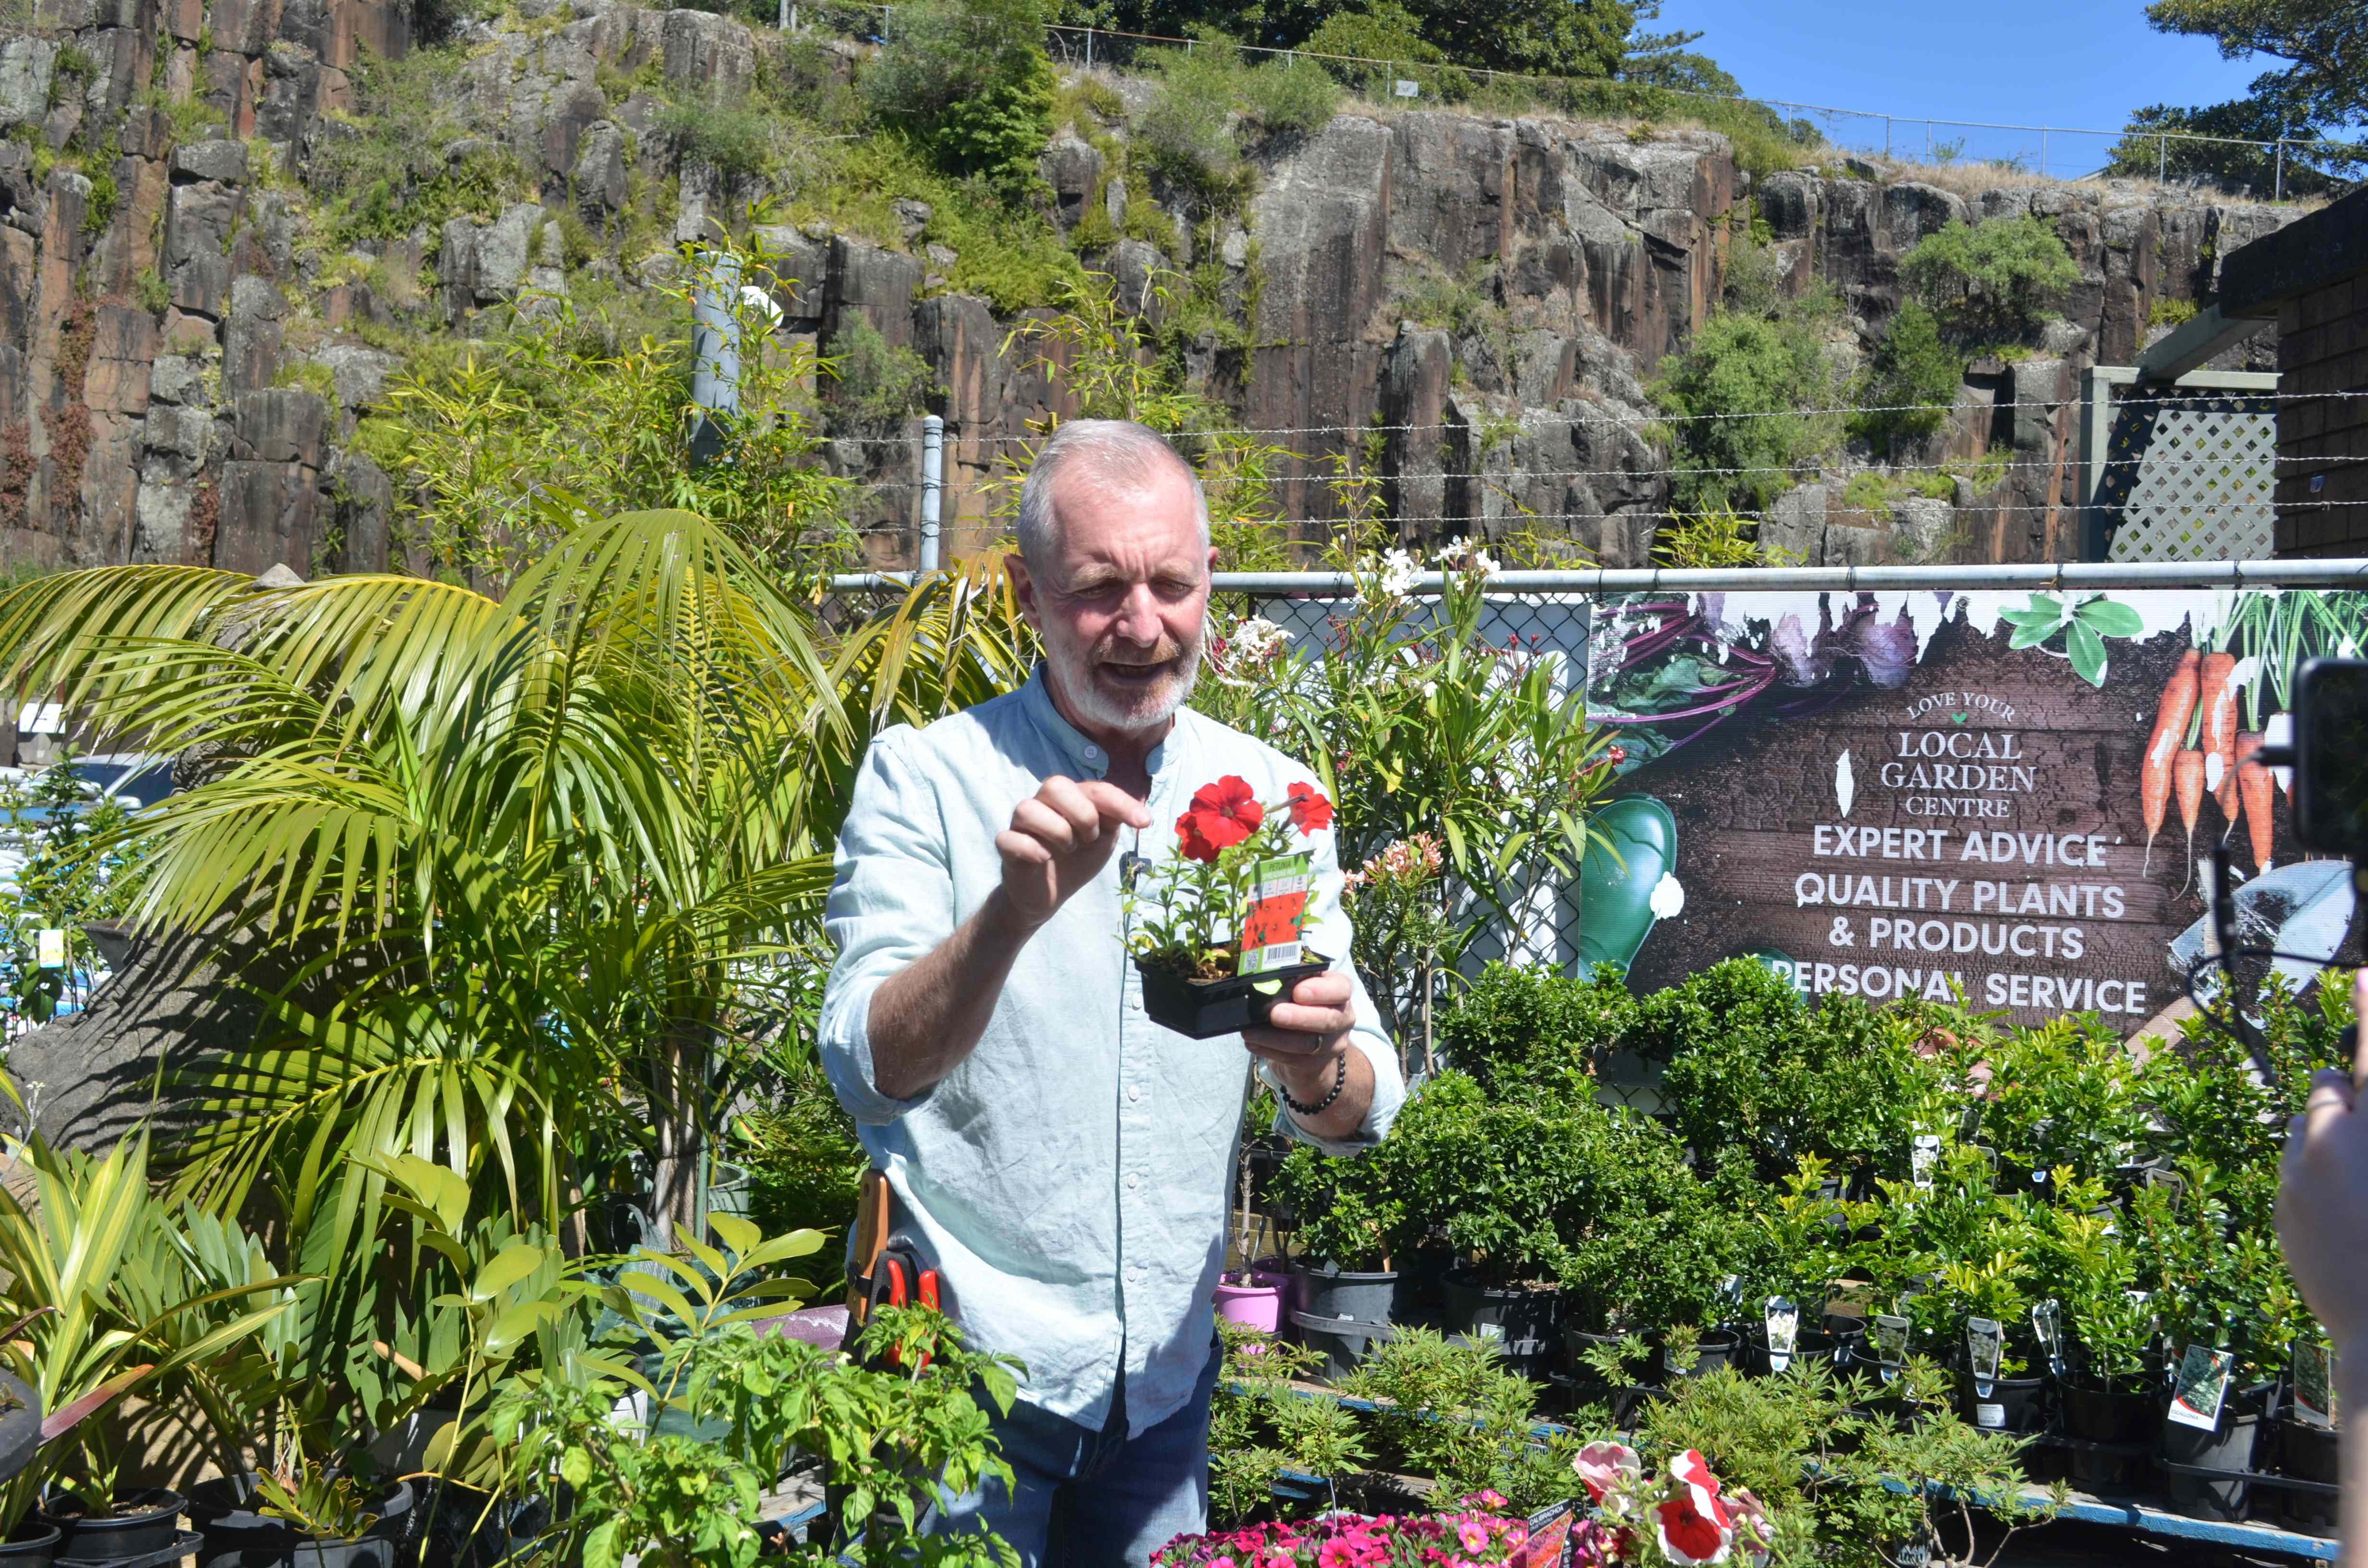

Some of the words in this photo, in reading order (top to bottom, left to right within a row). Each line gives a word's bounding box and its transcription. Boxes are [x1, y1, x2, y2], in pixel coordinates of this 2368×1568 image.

[1906, 692, 1956, 720] LOVE
[1961, 692, 2015, 723] YOUR
[1898, 731, 2022, 759] LOCAL
[1880, 762, 2037, 792] GARDEN
[1905, 796, 2010, 818] CENTRE
[1813, 824, 1948, 858] EXPERT
[1960, 831, 2107, 867] ADVICE
[1795, 872, 1960, 909] QUALITY
[1973, 881, 2125, 919] PLANTS
[1828, 916, 1855, 947] &
[1870, 917, 2084, 960] PRODUCTS
[1772, 960, 1970, 1003] PERSONAL
[1986, 972, 2146, 1015] SERVICE
[1529, 1505, 1564, 1526] CALIBRACHOA
